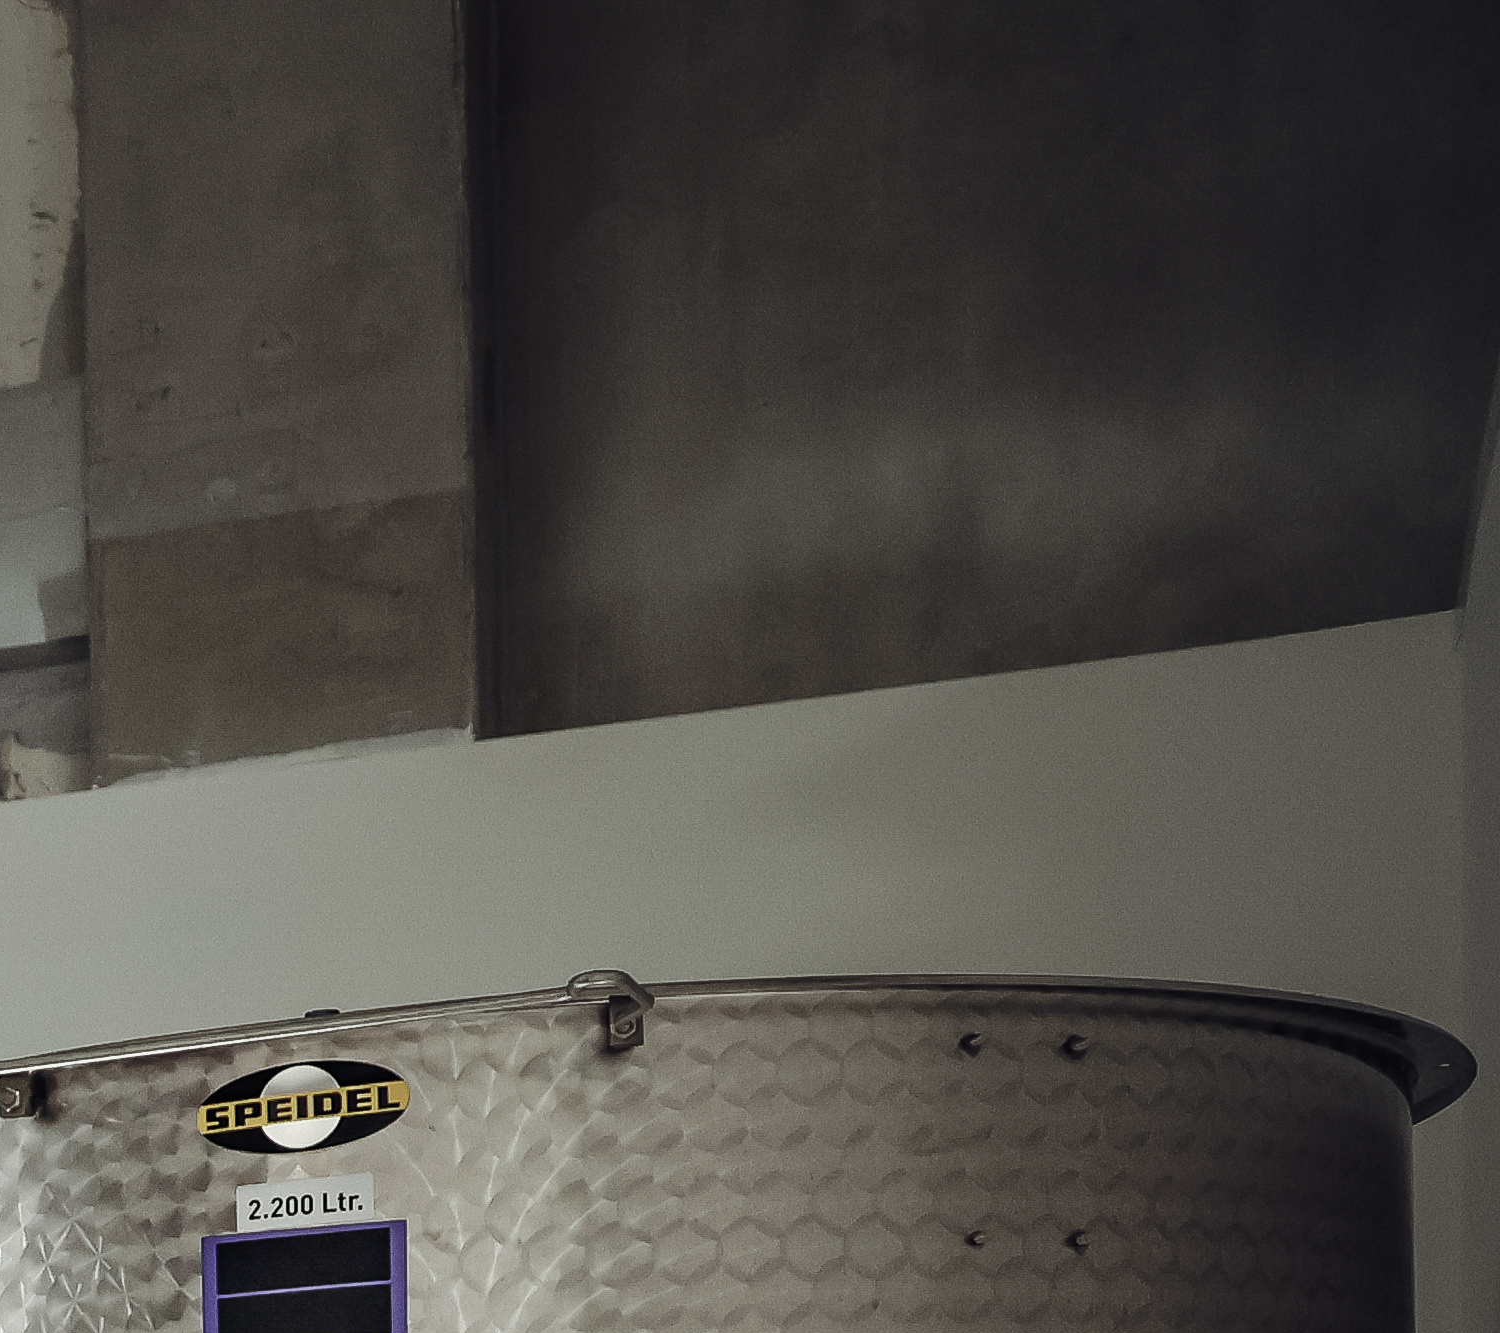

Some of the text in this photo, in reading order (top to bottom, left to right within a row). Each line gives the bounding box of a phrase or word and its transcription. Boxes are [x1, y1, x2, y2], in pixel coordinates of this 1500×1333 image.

[206, 1085, 401, 1131] SPEIDEL
[248, 1192, 363, 1220] 2.200 Ltr.
